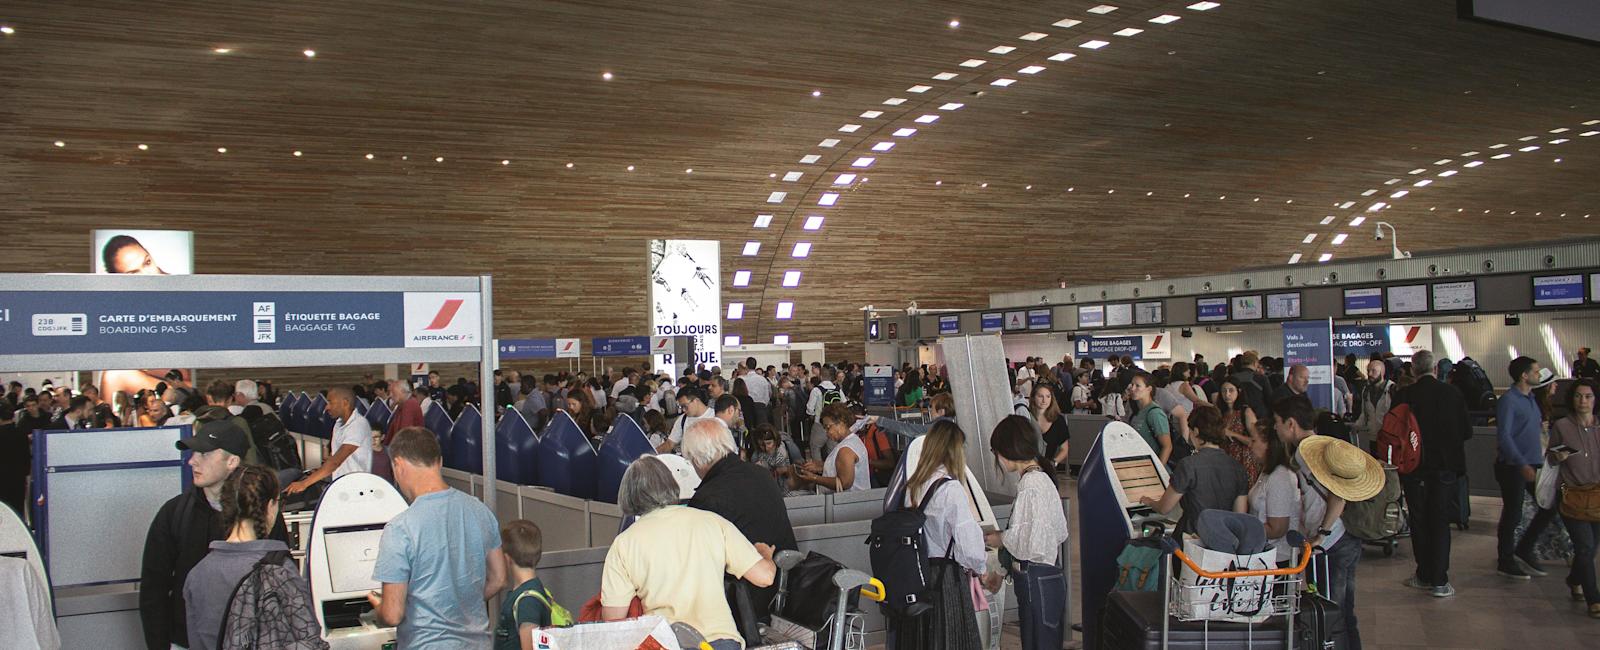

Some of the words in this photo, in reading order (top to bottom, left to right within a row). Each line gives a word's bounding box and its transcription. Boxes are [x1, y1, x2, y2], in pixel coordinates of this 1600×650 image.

[257, 305, 271, 313] AF
[99, 314, 135, 323] CARTE
[138, 313, 238, 323] D'EMBARQUEMENT
[284, 312, 337, 321] ÉTIQUETTE
[338, 312, 381, 321] BAGAGE
[99, 325, 158, 334] BOARDING
[161, 325, 188, 333] PASS
[284, 323, 334, 332] BAGGAGE
[336, 323, 356, 331] TAG
[656, 325, 718, 335] TOUJOURS
[871, 324, 877, 336] 4
[1341, 332, 1374, 340] BAGAGES
